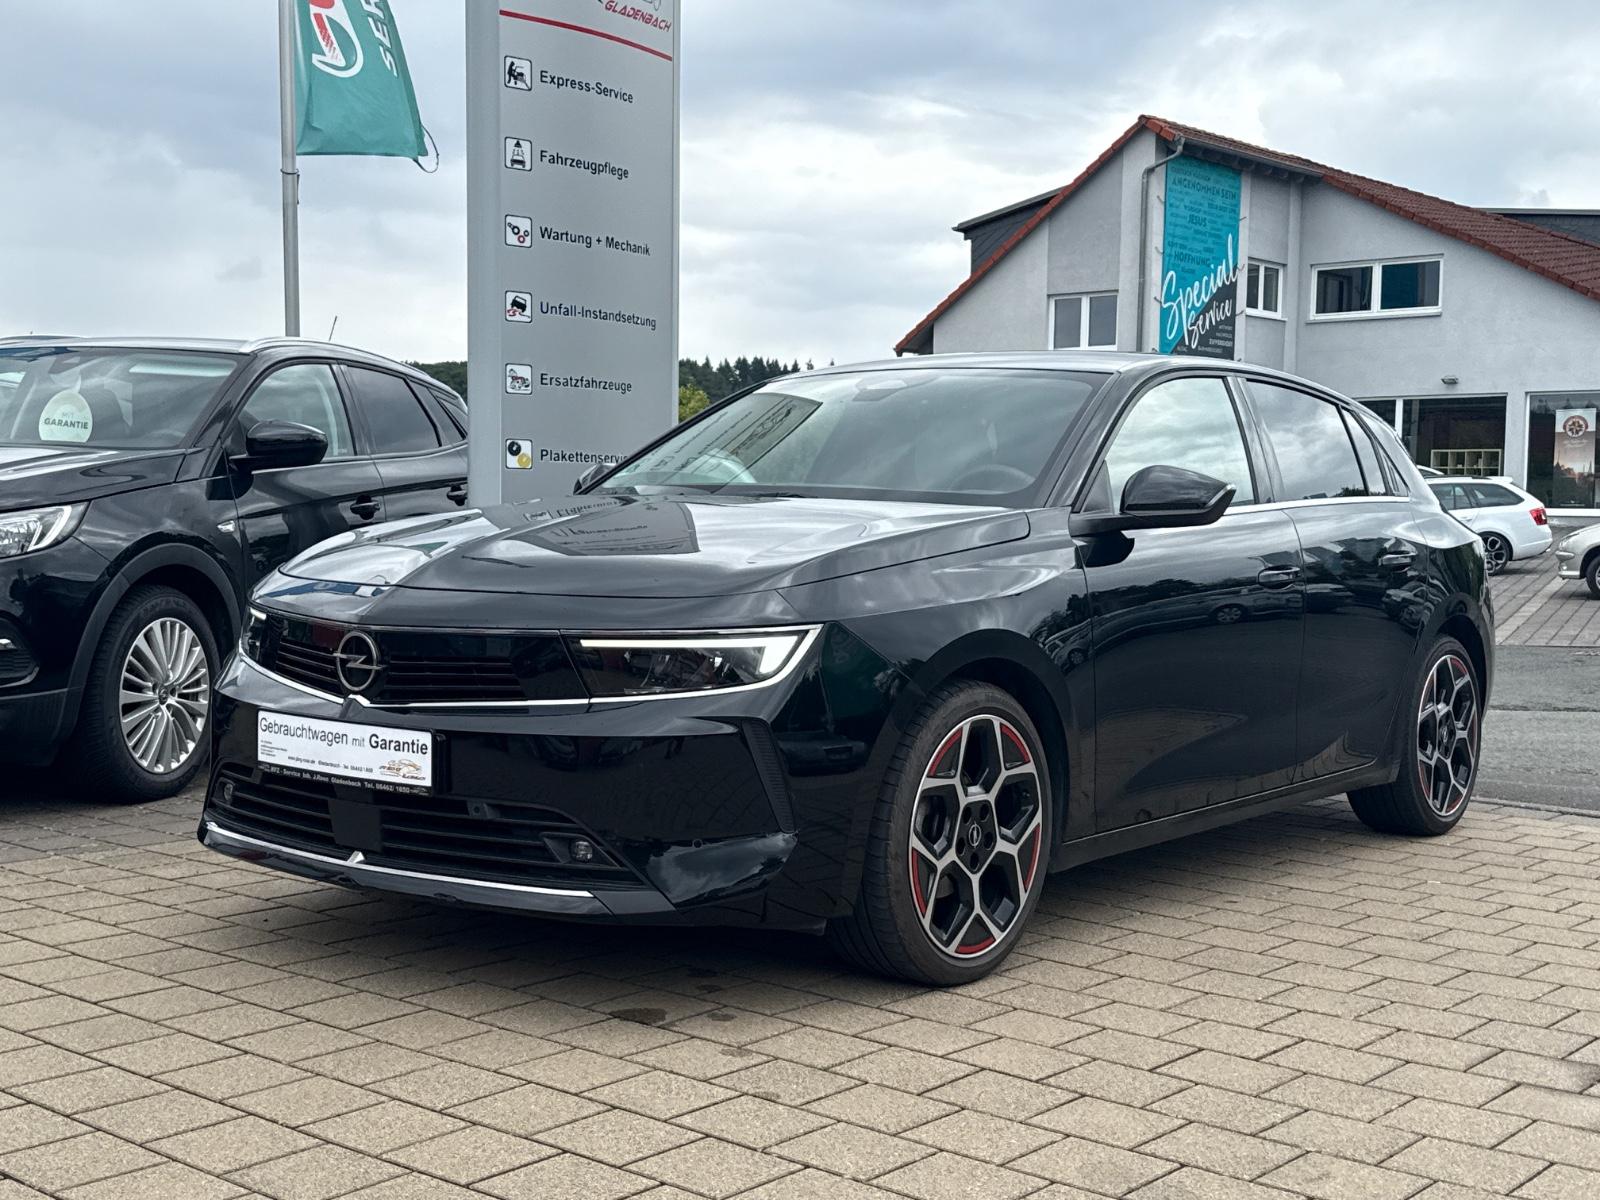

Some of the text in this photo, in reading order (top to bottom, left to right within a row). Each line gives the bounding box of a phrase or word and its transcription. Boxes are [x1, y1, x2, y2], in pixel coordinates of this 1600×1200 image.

[605, 0, 672, 32] GLADENBACH
[540, 70, 634, 103] Express-Service
[540, 150, 629, 180] Fahrzeugpflege
[539, 226, 592, 248] Wartung
[605, 236, 650, 256] Mechanik
[1161, 232, 1240, 346] Special
[540, 301, 657, 331] Unfall-Instandsetzung
[1188, 298, 1232, 349] Service
[540, 373, 632, 395] Ersatzfahrzeuge
[44, 417, 89, 430] GARANTIE
[259, 717, 428, 755] Gebrauchtwagen mit Garantie
